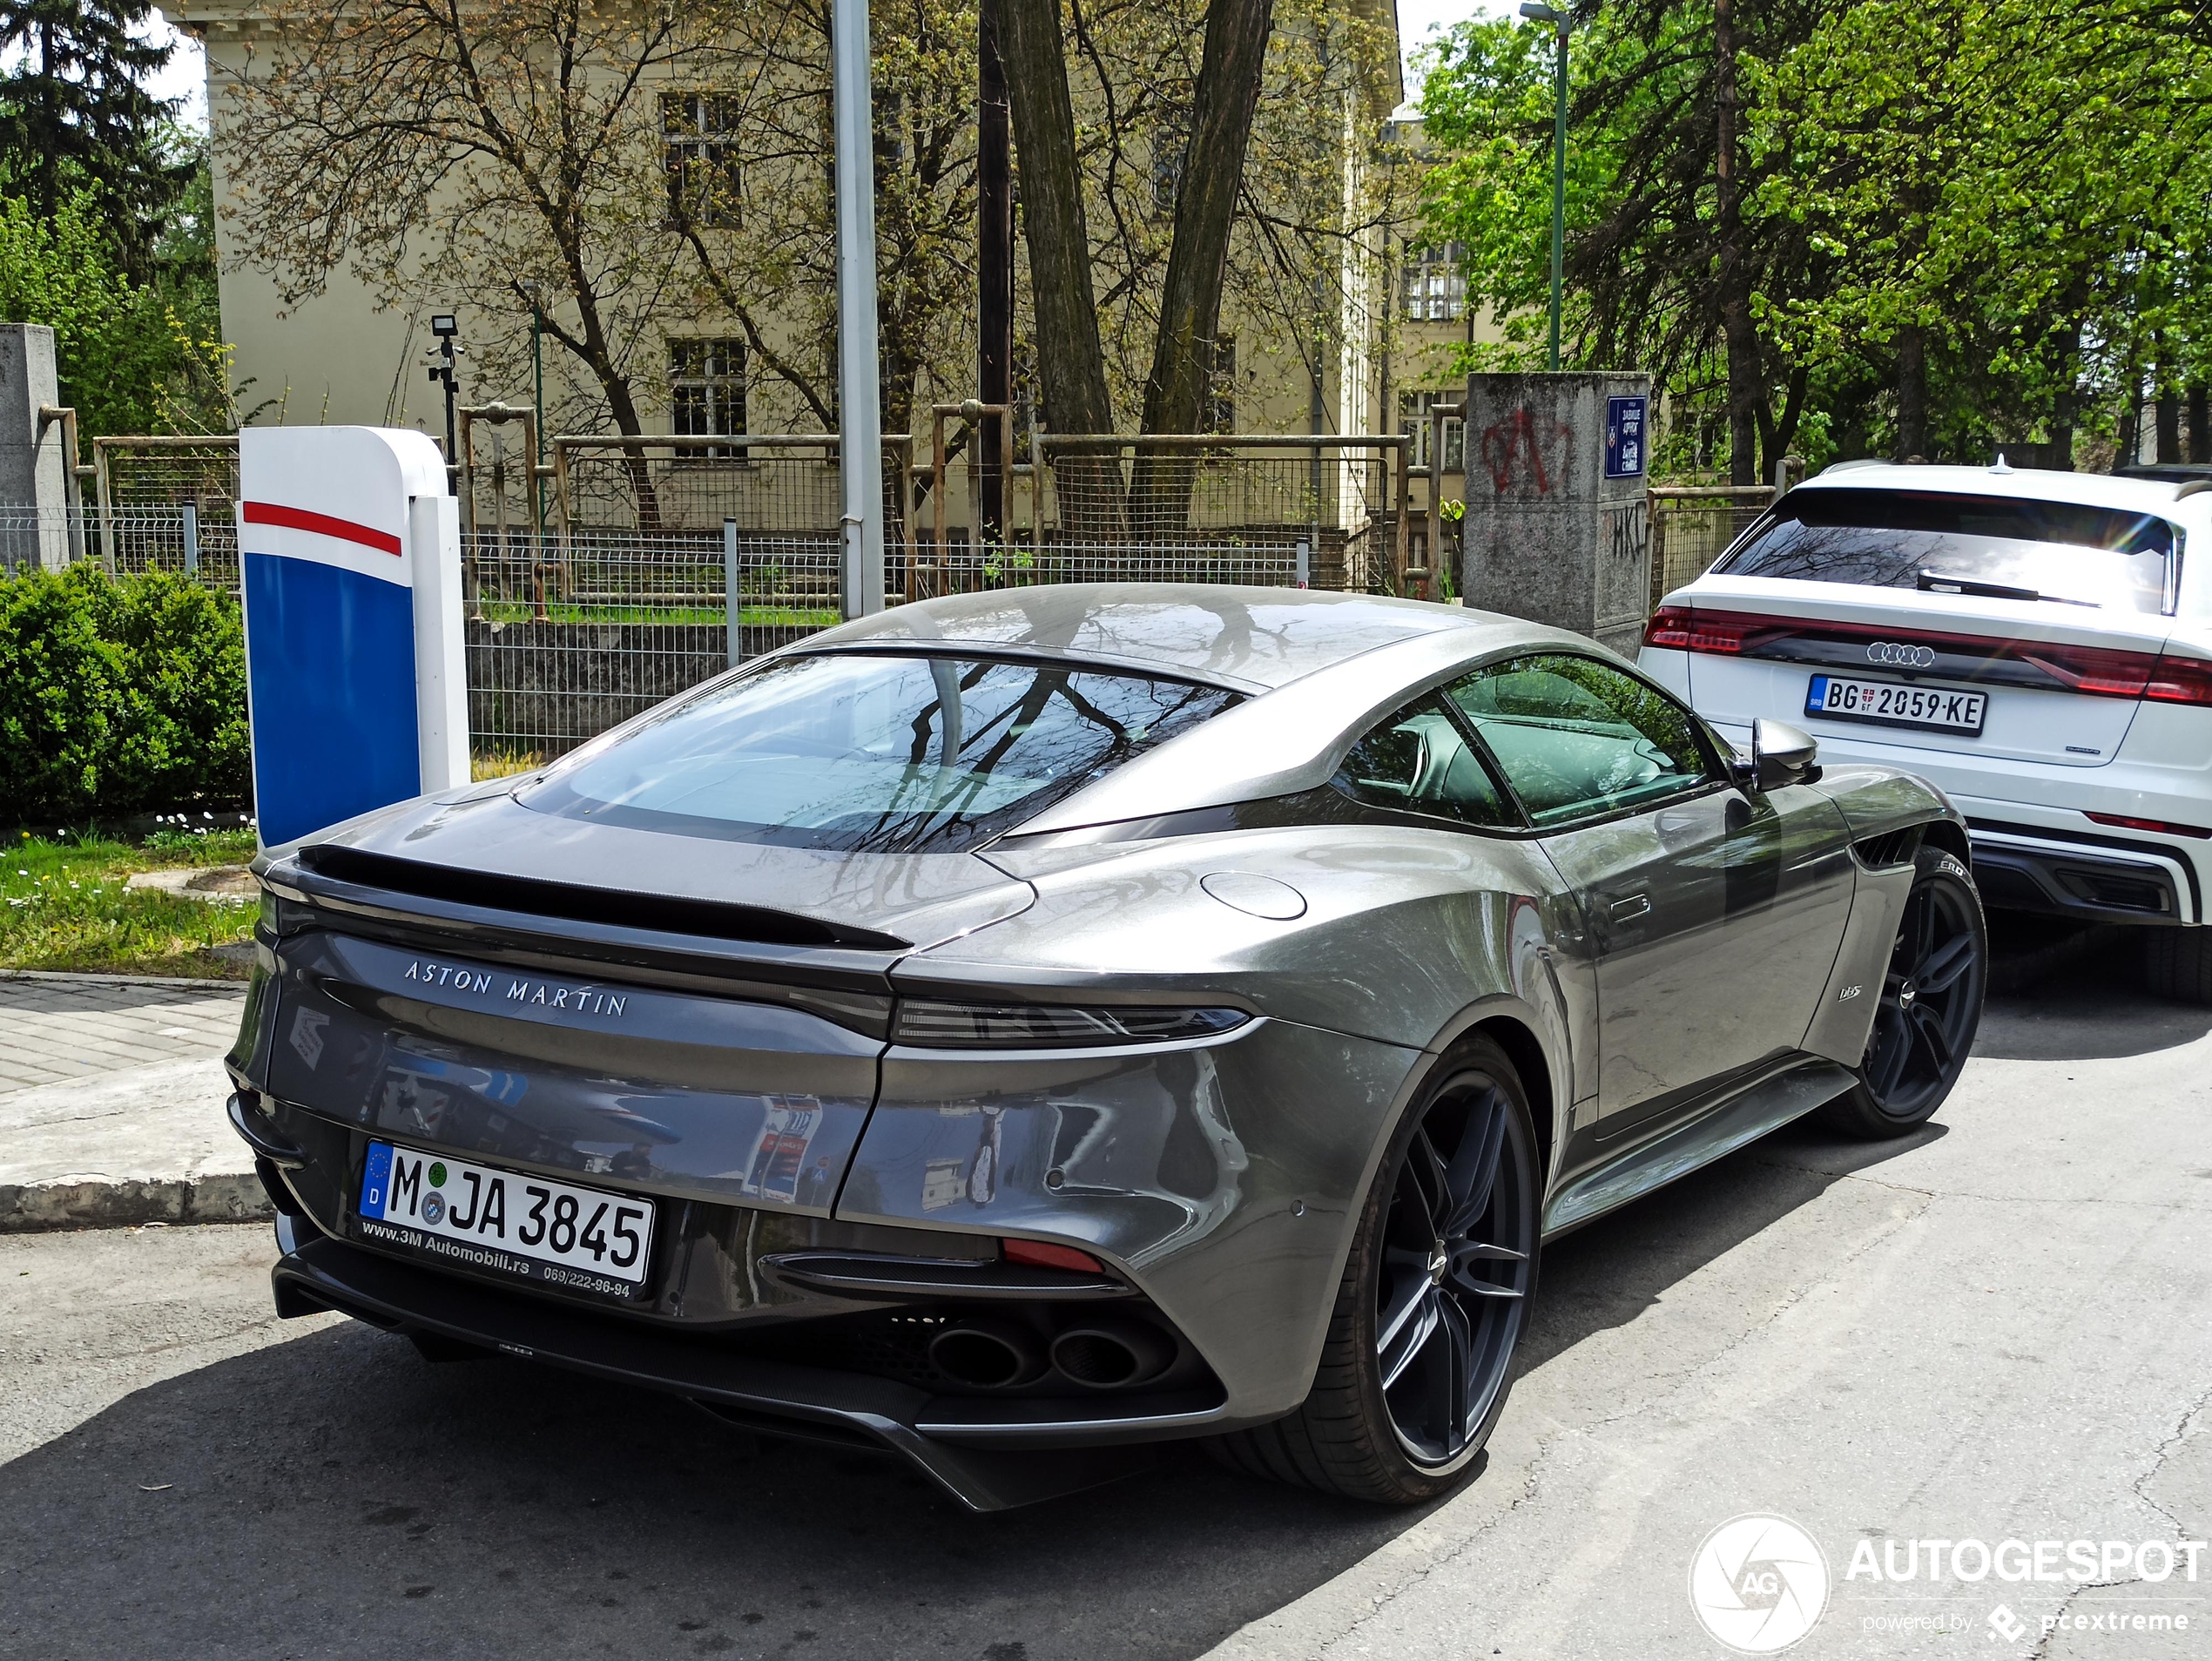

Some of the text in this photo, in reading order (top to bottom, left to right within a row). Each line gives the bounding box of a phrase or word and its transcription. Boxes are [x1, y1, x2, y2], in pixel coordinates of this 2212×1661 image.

[1827, 683, 1858, 709] BG
[404, 961, 627, 1016] ASTON MARTIN
[369, 1188, 378, 1205] D
[389, 1156, 644, 1268] M JA 3845
[362, 1221, 631, 1298] www.3M Automobili.rs 069/222-96-94
